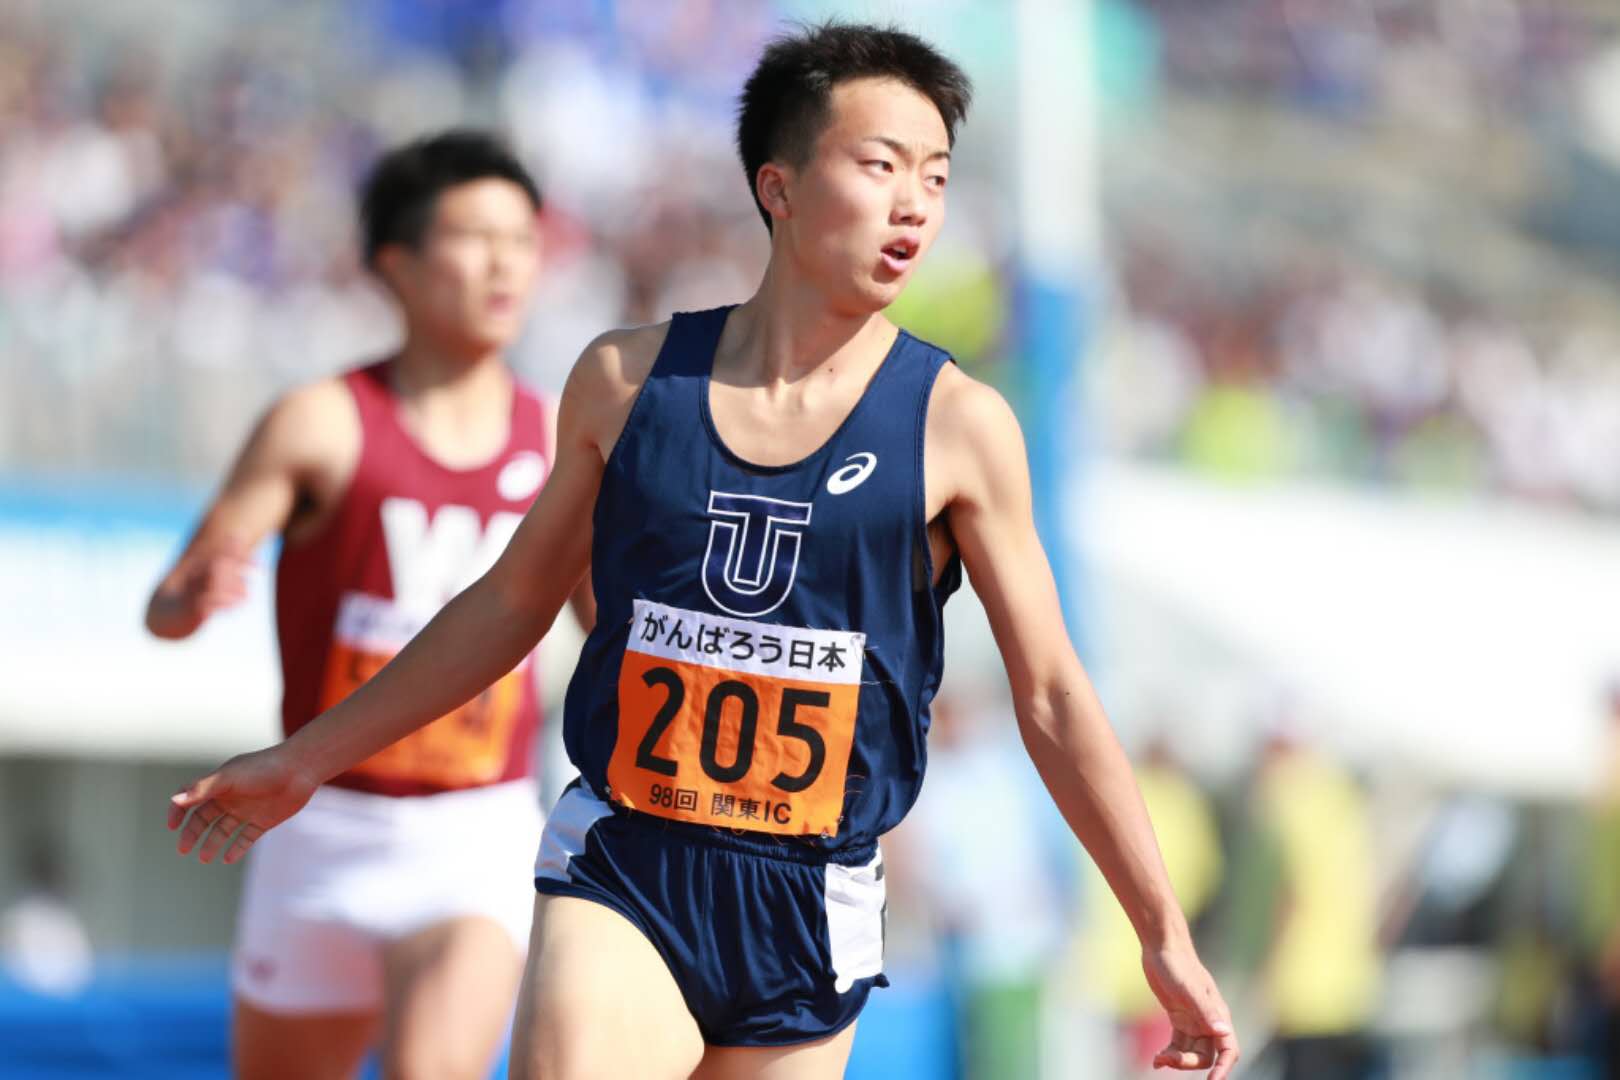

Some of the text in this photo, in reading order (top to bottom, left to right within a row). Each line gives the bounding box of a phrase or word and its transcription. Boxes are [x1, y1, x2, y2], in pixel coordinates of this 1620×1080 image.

[640, 611, 847, 673] がんばろう日本
[634, 666, 831, 793] 205
[649, 783, 792, 825] 98回 関東IC
